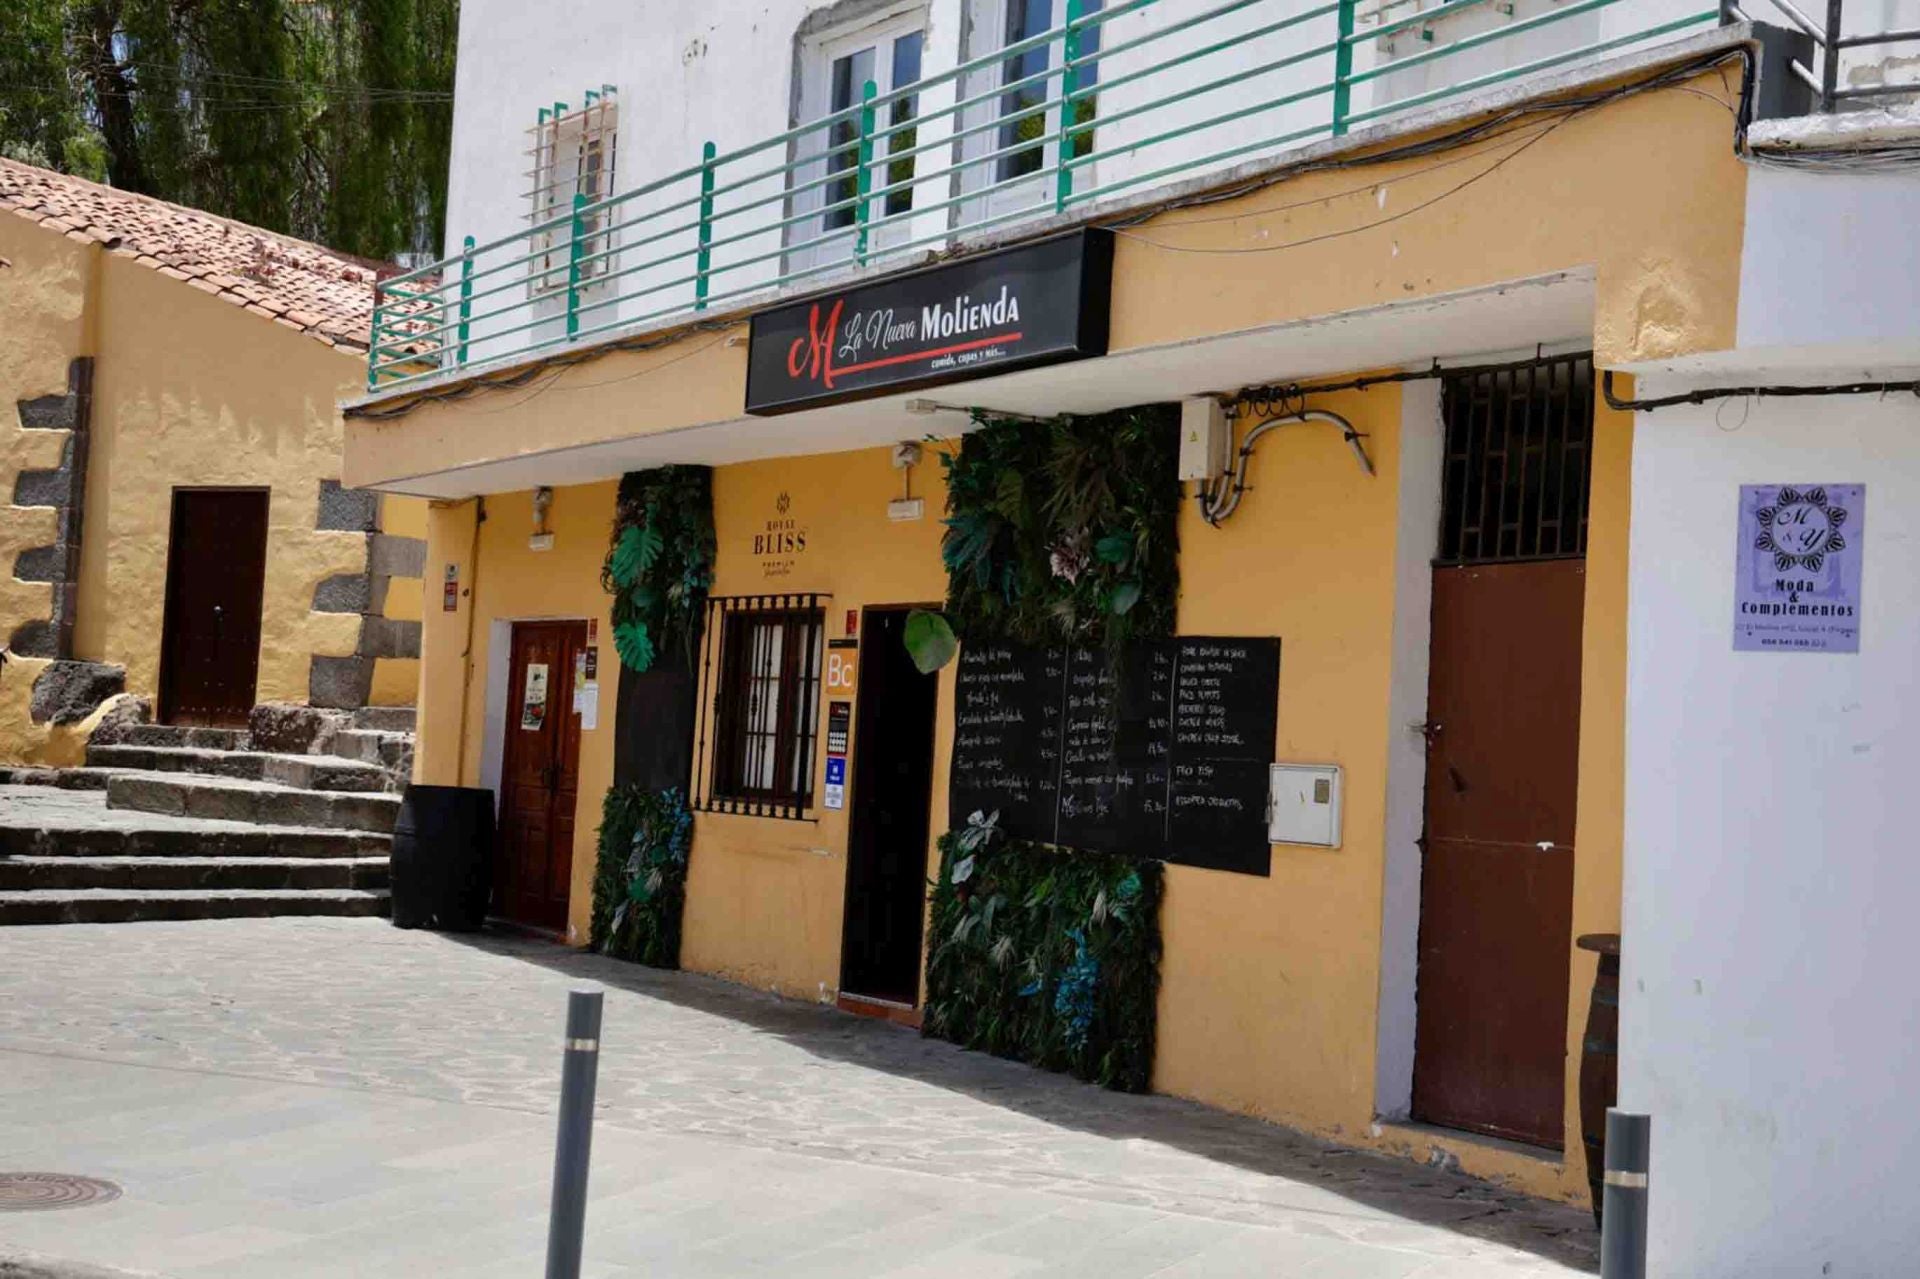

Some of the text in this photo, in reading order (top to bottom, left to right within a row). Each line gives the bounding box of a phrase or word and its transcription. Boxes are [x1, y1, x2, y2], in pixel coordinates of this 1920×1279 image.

[787, 299, 845, 390] M
[838, 312, 863, 362] La
[865, 308, 917, 350] Nueva
[754, 531, 806, 555] BLISS
[1776, 579, 1815, 593] Moda
[1789, 591, 1800, 603] &
[1741, 602, 1854, 617] Complementos
[828, 653, 853, 688] Bc
